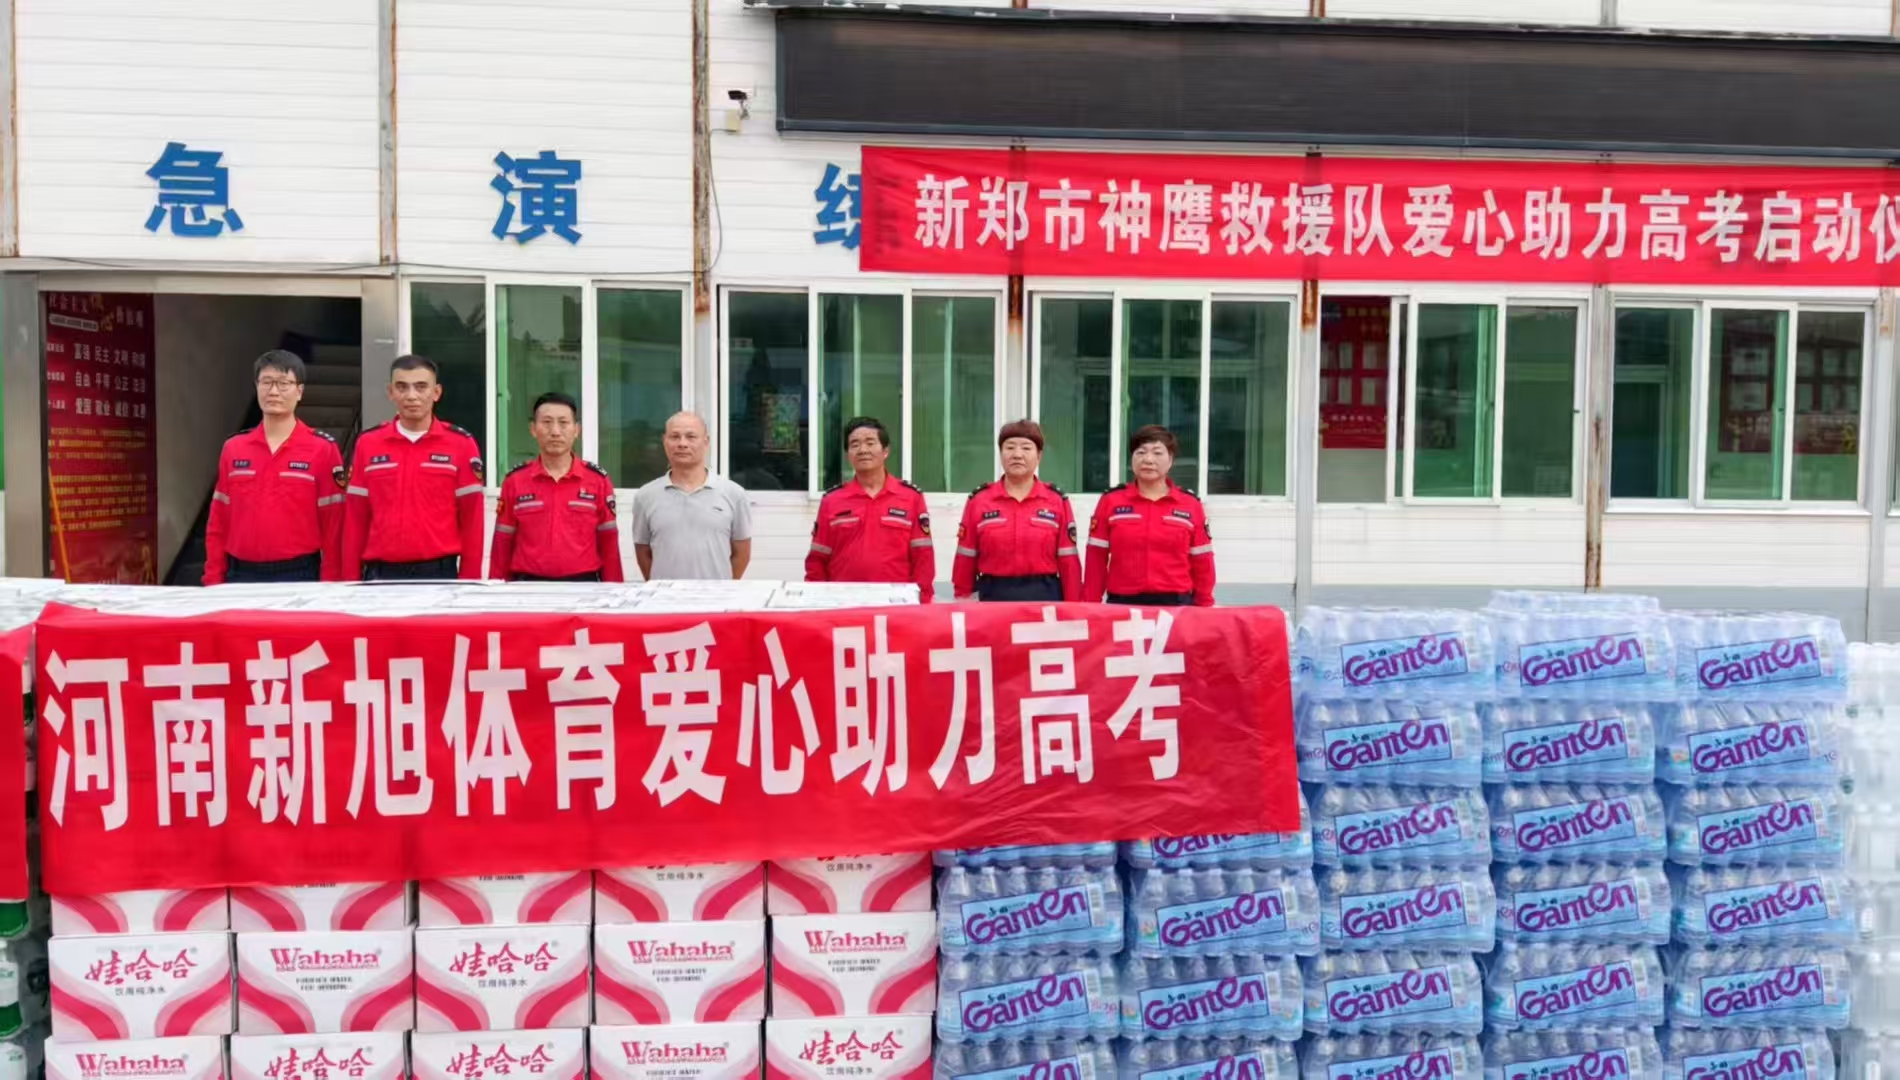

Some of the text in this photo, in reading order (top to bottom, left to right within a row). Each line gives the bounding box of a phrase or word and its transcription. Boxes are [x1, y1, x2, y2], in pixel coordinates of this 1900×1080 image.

[146, 143, 583, 245] 急 演
[915, 173, 1900, 264] 新郑市神鹰救援队爱心助力高考启动仪
[43, 606, 1185, 831] 河南新旭体育爱心助力高考
[270, 948, 378, 966] Wahaha
[627, 940, 733, 958] Wahaha
[804, 931, 905, 949] Wahaha
[85, 948, 198, 985] 娃哈哈
[449, 942, 558, 977] 娃哈哈
[76, 1053, 184, 1072] Wahaha
[264, 1047, 374, 1080] 娃哈哈
[446, 1043, 554, 1078] 娃哈哈
[621, 1041, 726, 1059] Wahaha
[799, 1030, 903, 1065] 娃哈哈
